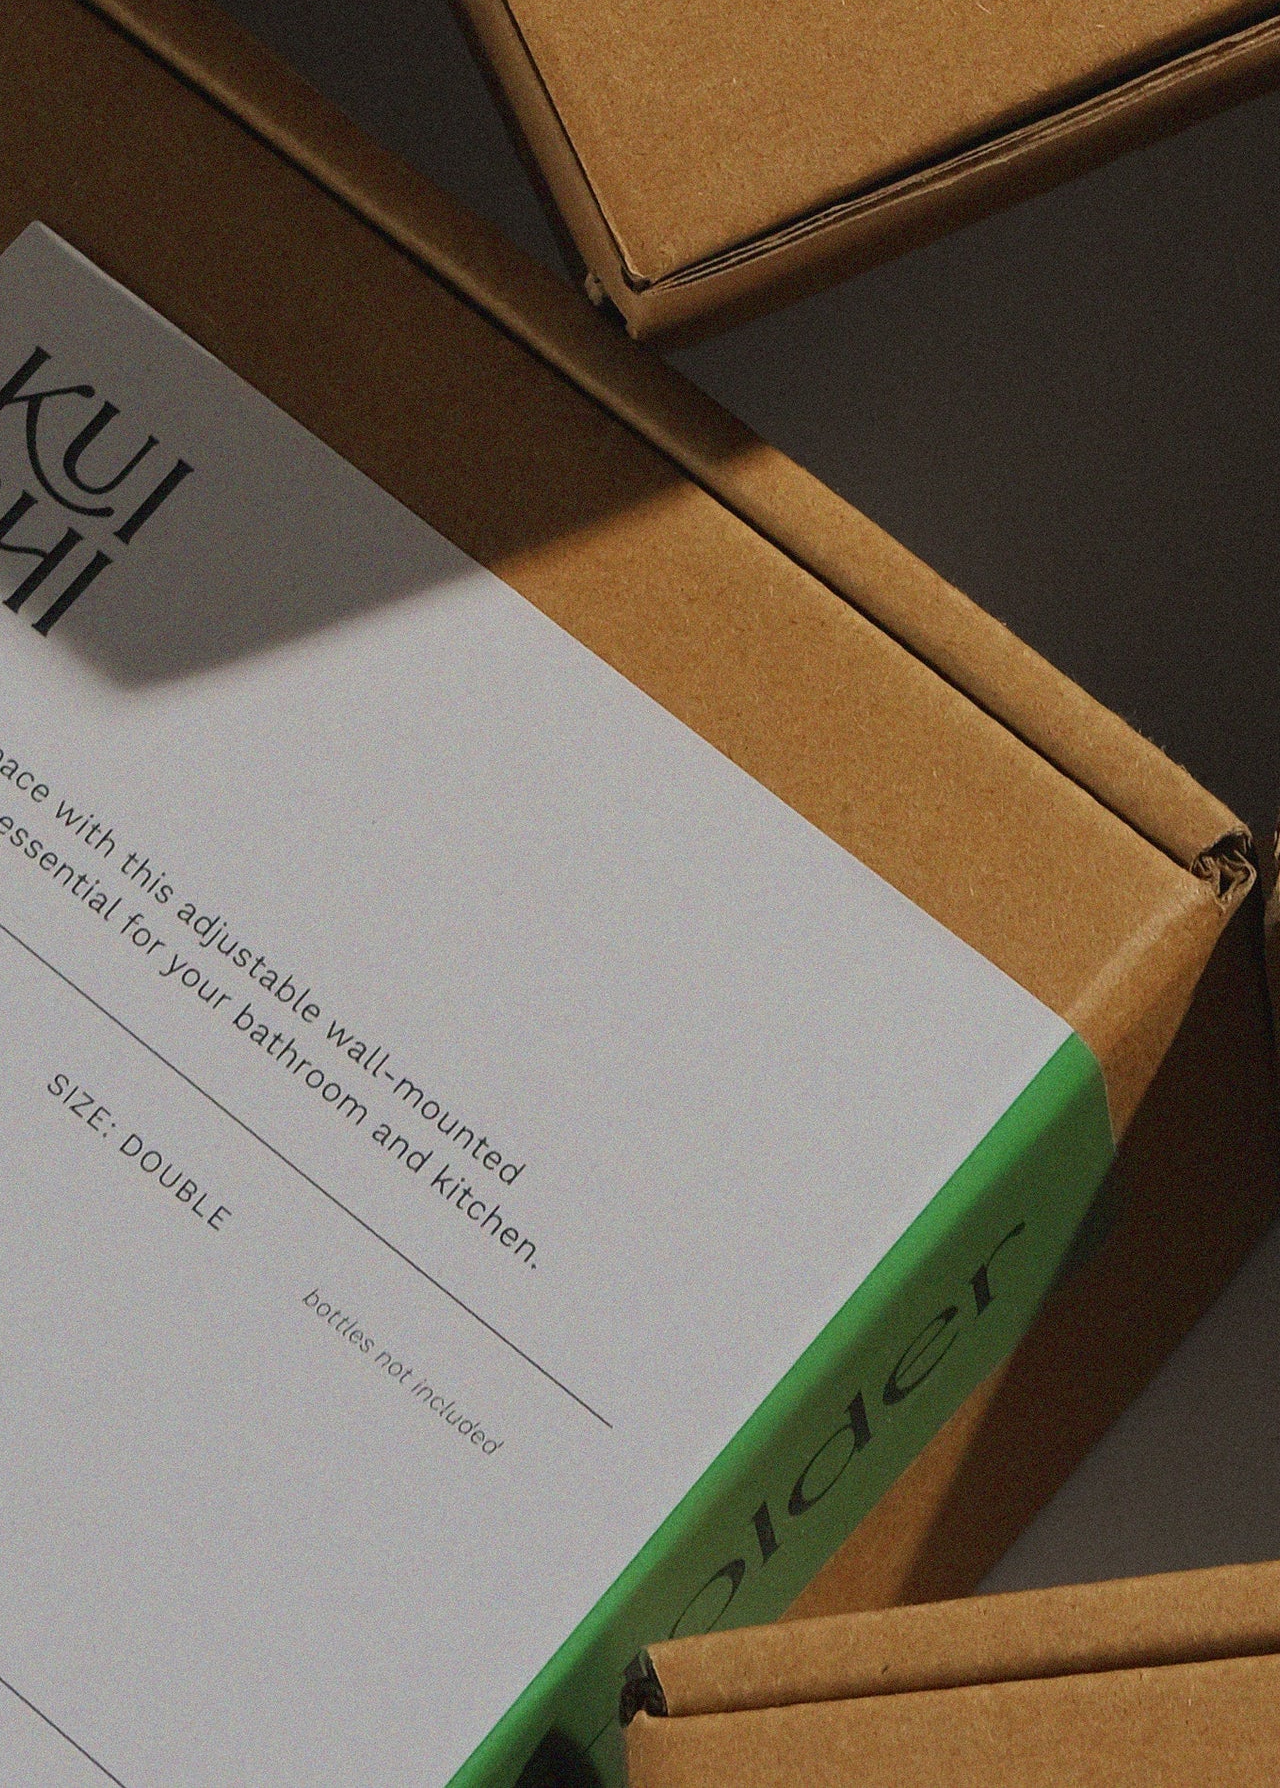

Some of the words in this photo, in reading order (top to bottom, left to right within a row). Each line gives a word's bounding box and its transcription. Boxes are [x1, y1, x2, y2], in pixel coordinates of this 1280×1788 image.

[46, 1072, 117, 1139] SIZE:
[118, 1132, 233, 1232] DOUBLE
[54, 799, 116, 859] with
[120, 851, 175, 905] this
[175, 901, 322, 1024] adjustable
[325, 1019, 528, 1187] wall-mounted
[119, 912, 167, 956] for
[157, 952, 233, 1010] your
[231, 1001, 369, 1127] bathroom
[370, 1122, 434, 1174] and
[429, 1163, 538, 1271] kitchen.
[301, 1287, 376, 1354] bottles
[373, 1350, 414, 1385] not
[410, 1378, 505, 1456] included
[650, 1220, 1027, 1648] older
